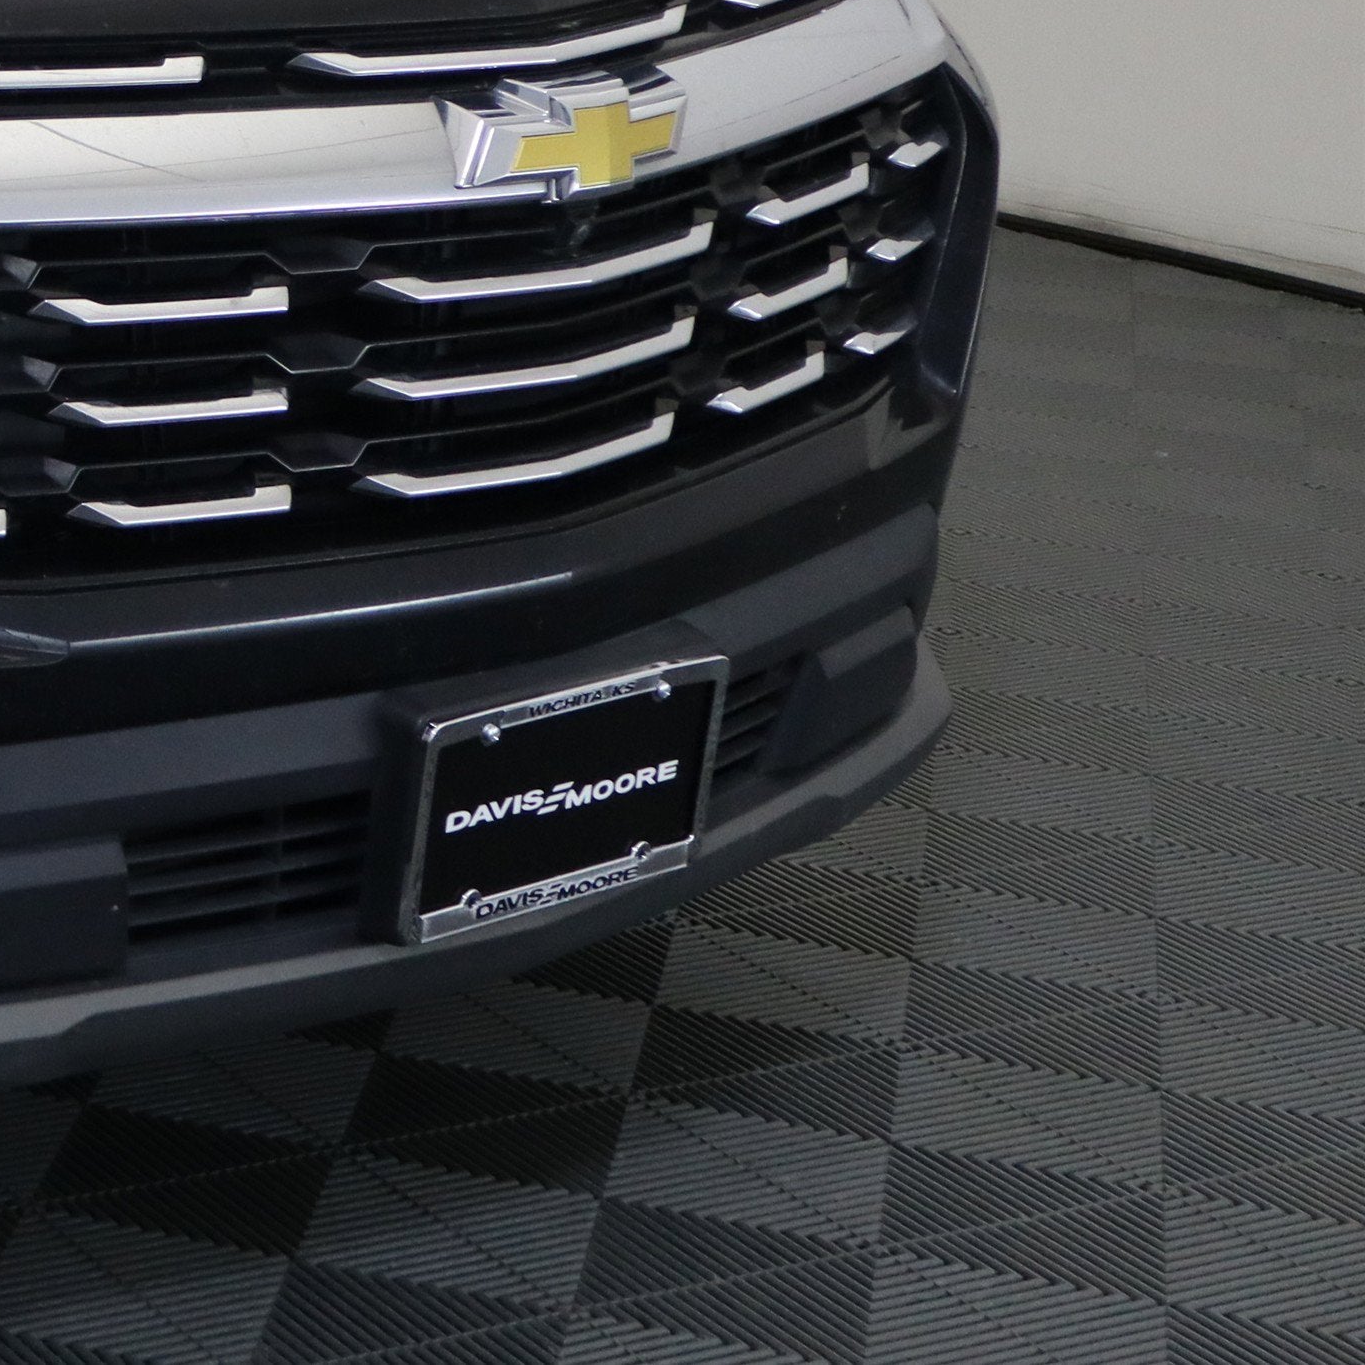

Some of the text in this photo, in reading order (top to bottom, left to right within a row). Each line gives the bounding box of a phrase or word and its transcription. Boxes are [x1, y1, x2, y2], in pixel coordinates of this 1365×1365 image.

[528, 681, 637, 719] WICHITA KS
[445, 758, 680, 834] DAVIS MOORE
[475, 866, 639, 920] DAVIS MOORE
